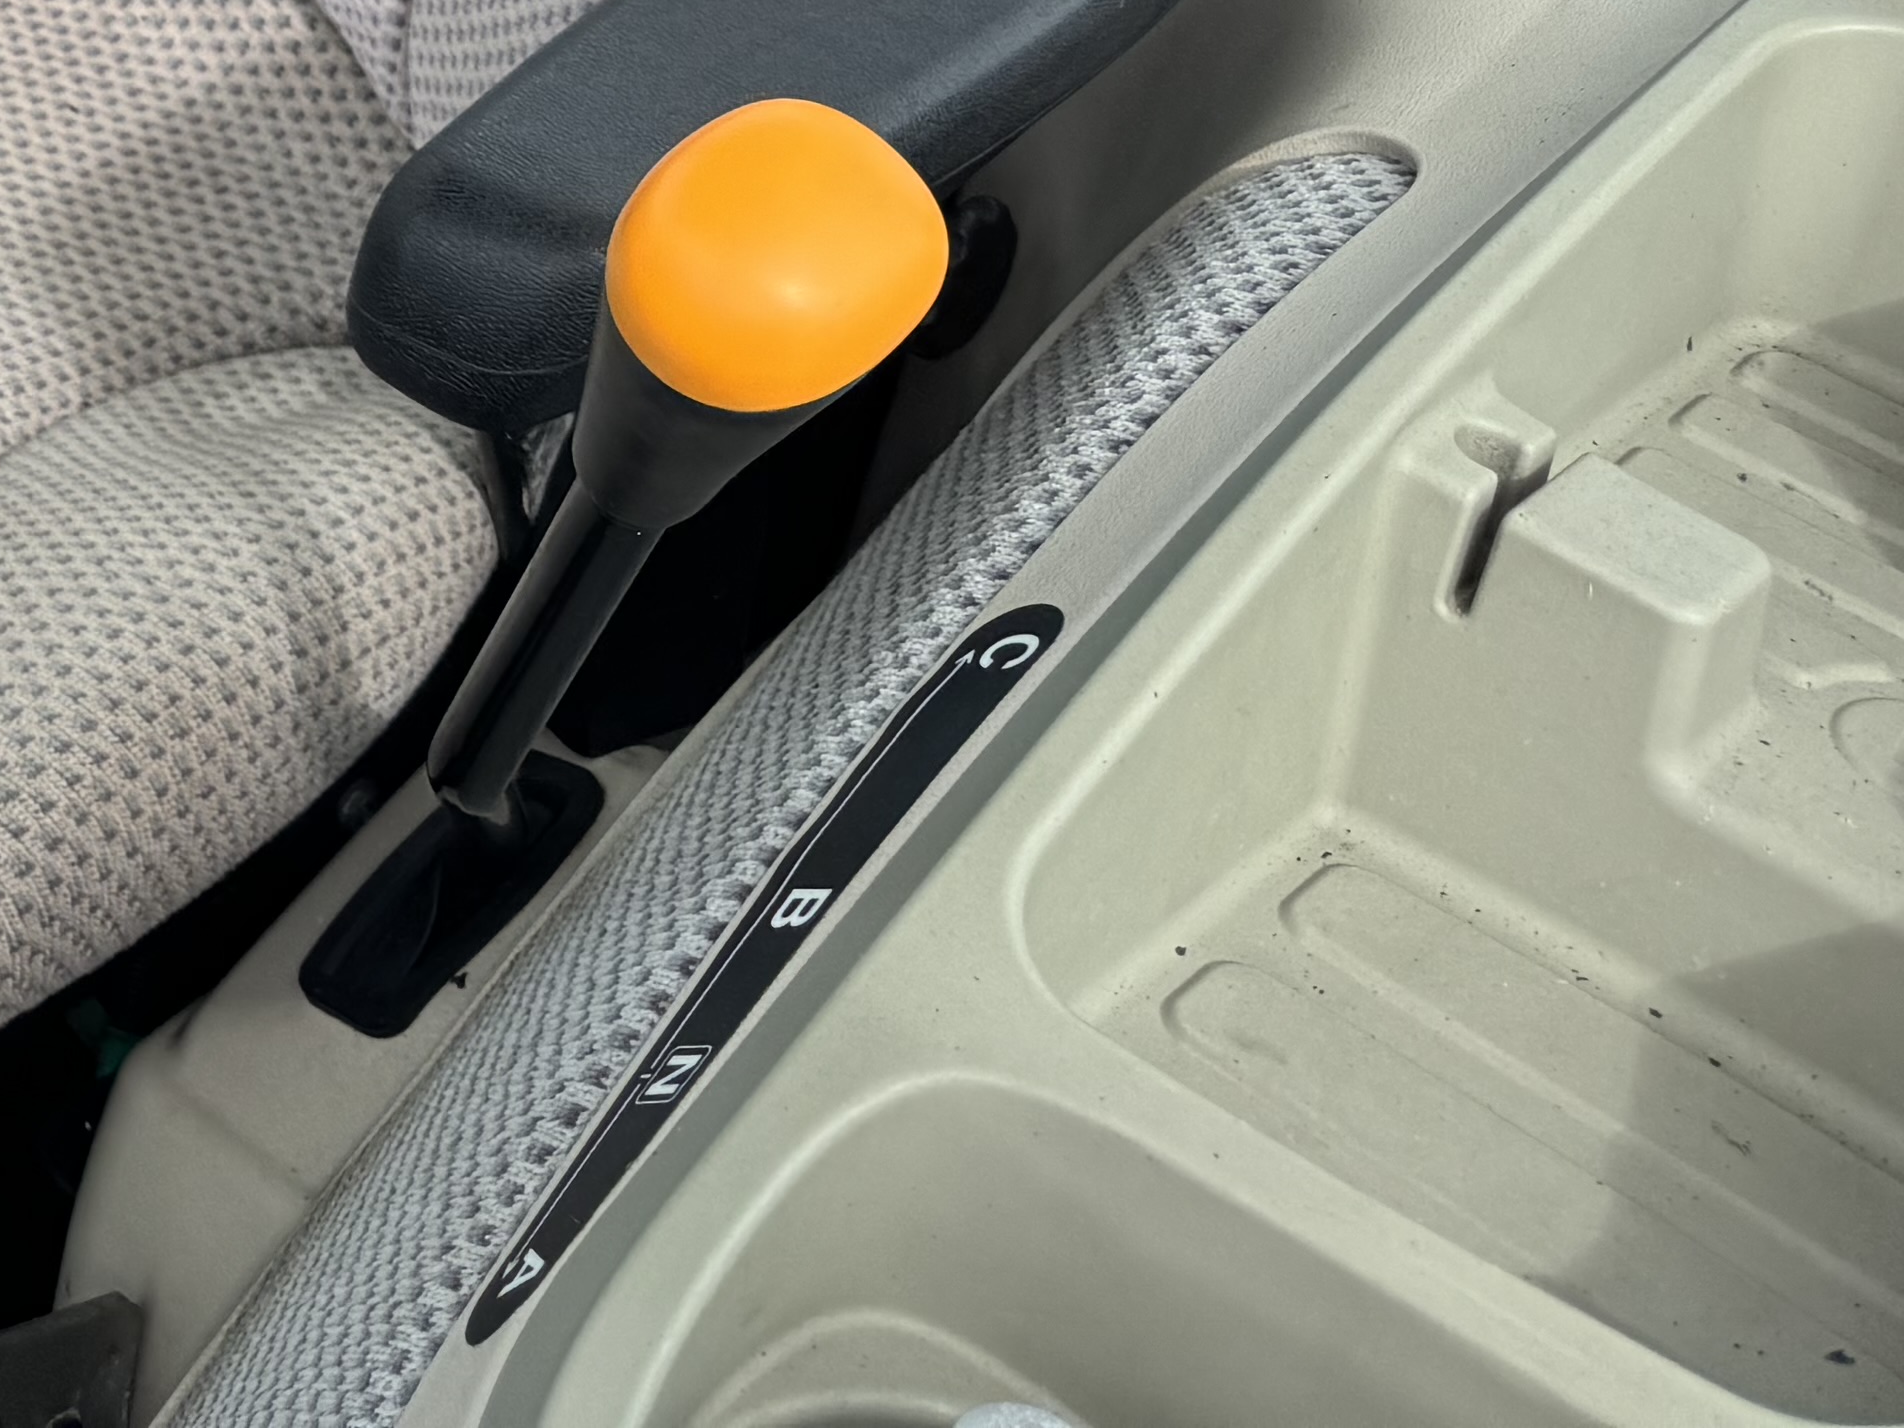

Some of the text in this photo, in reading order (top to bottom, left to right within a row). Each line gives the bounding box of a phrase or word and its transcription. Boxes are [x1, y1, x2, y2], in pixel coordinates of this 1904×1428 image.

[979, 633, 1040, 670] C
[770, 888, 833, 928] B
[644, 1054, 703, 1095] N
[496, 1248, 545, 1299] A
